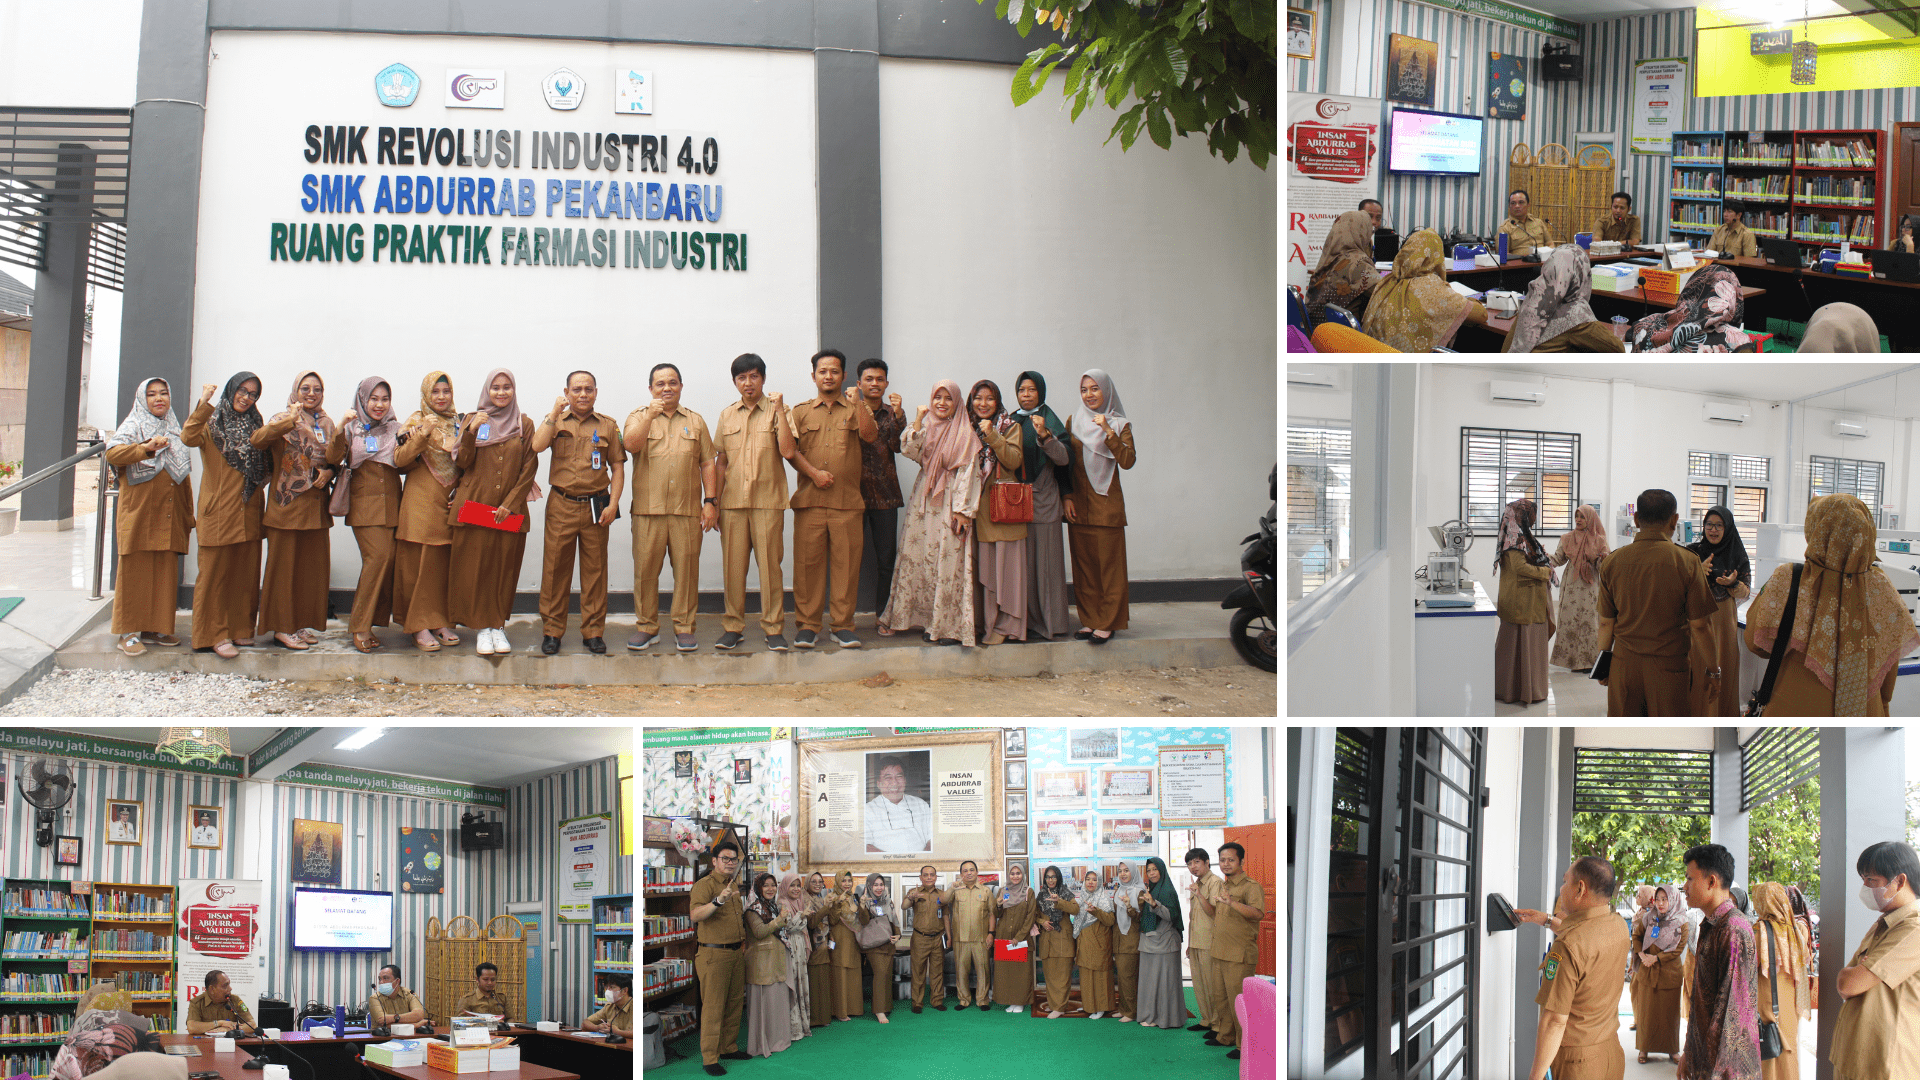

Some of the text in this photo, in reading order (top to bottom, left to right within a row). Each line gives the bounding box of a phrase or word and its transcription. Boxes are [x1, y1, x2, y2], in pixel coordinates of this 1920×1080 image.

[1483, 3, 1514, 19] bekerja
[1514, 11, 1537, 25] tekun
[1537, 17, 1545, 27] di
[1544, 20, 1562, 31] jalan
[1316, 131, 1347, 140] INSAN
[1306, 138, 1357, 149] ABDURRAB
[303, 124, 719, 175] SMK REVOLUSI INDUSTRI 4.0
[1315, 146, 1349, 156] VALUES
[300, 173, 723, 223] SMK ABDURRAB PEKANBARU
[1289, 212, 1308, 235] R
[269, 222, 748, 272] RUANG PRAKTIK FARMASI INDUSTRI
[1288, 242, 1307, 267] A
[711, 732, 730, 740] hidup
[16, 735, 64, 750] melayu
[66, 739, 91, 754] jati,
[93, 743, 156, 762] bersangka
[817, 773, 826, 783] R
[303, 770, 333, 781] tanda
[335, 774, 370, 786] melayu
[370, 777, 390, 789] jati,
[392, 780, 425, 793] bekerja
[427, 785, 452, 796] tekun
[453, 788, 462, 797] di
[462, 789, 484, 800] jalan
[485, 792, 503, 802] ilahi
[940, 780, 982, 788] ABDURRAB
[817, 792, 828, 802] A
[817, 818, 826, 828] B
[207, 912, 233, 920] INSAN
[199, 919, 241, 928] ABDURRAB
[206, 927, 235, 935] VALUES
[186, 985, 200, 1002] R
